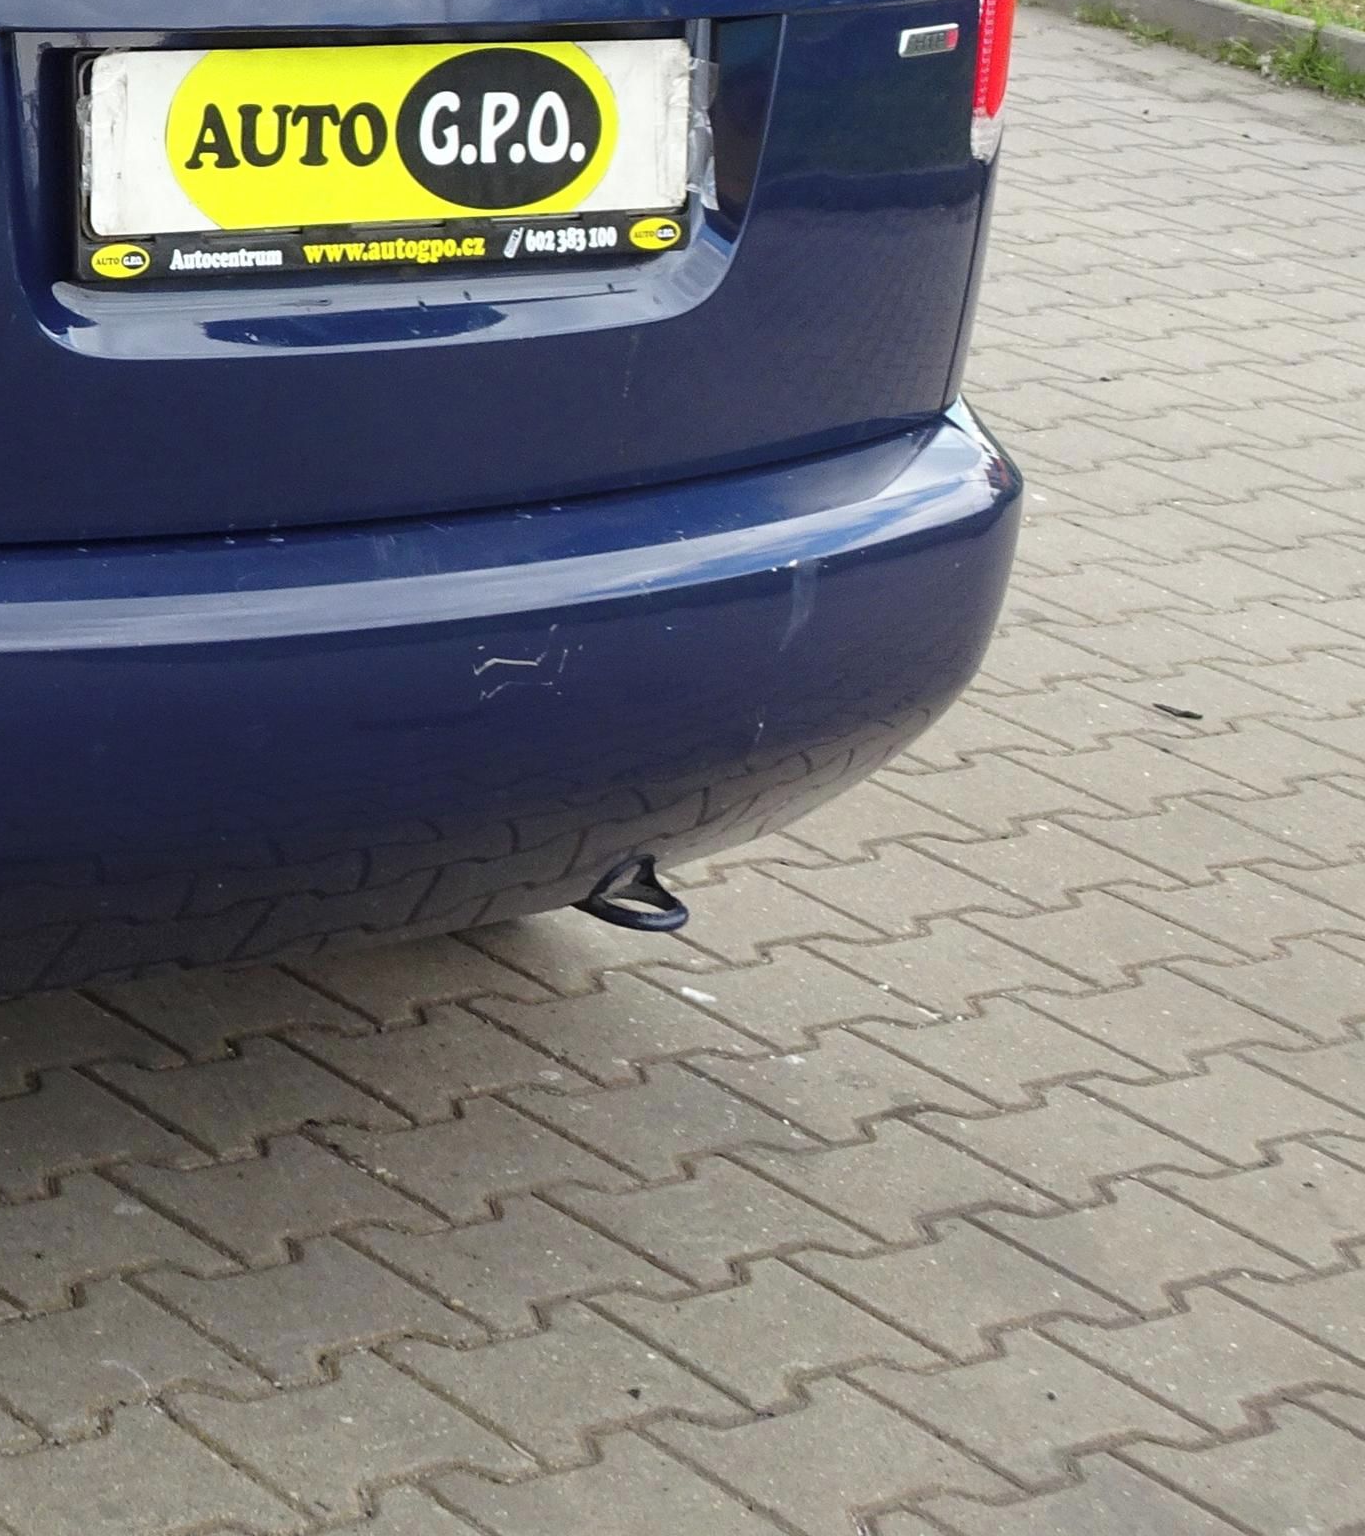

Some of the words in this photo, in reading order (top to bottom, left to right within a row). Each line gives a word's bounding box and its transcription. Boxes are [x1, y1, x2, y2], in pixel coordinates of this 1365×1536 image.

[184, 101, 389, 170] AUTO
[419, 90, 587, 165] G.P.O.
[95, 256, 120, 267] AUTO
[169, 248, 283, 271] Autocentrum
[302, 236, 486, 264] www.autogpo.cz
[525, 228, 556, 253] 602
[588, 225, 618, 248] 100
